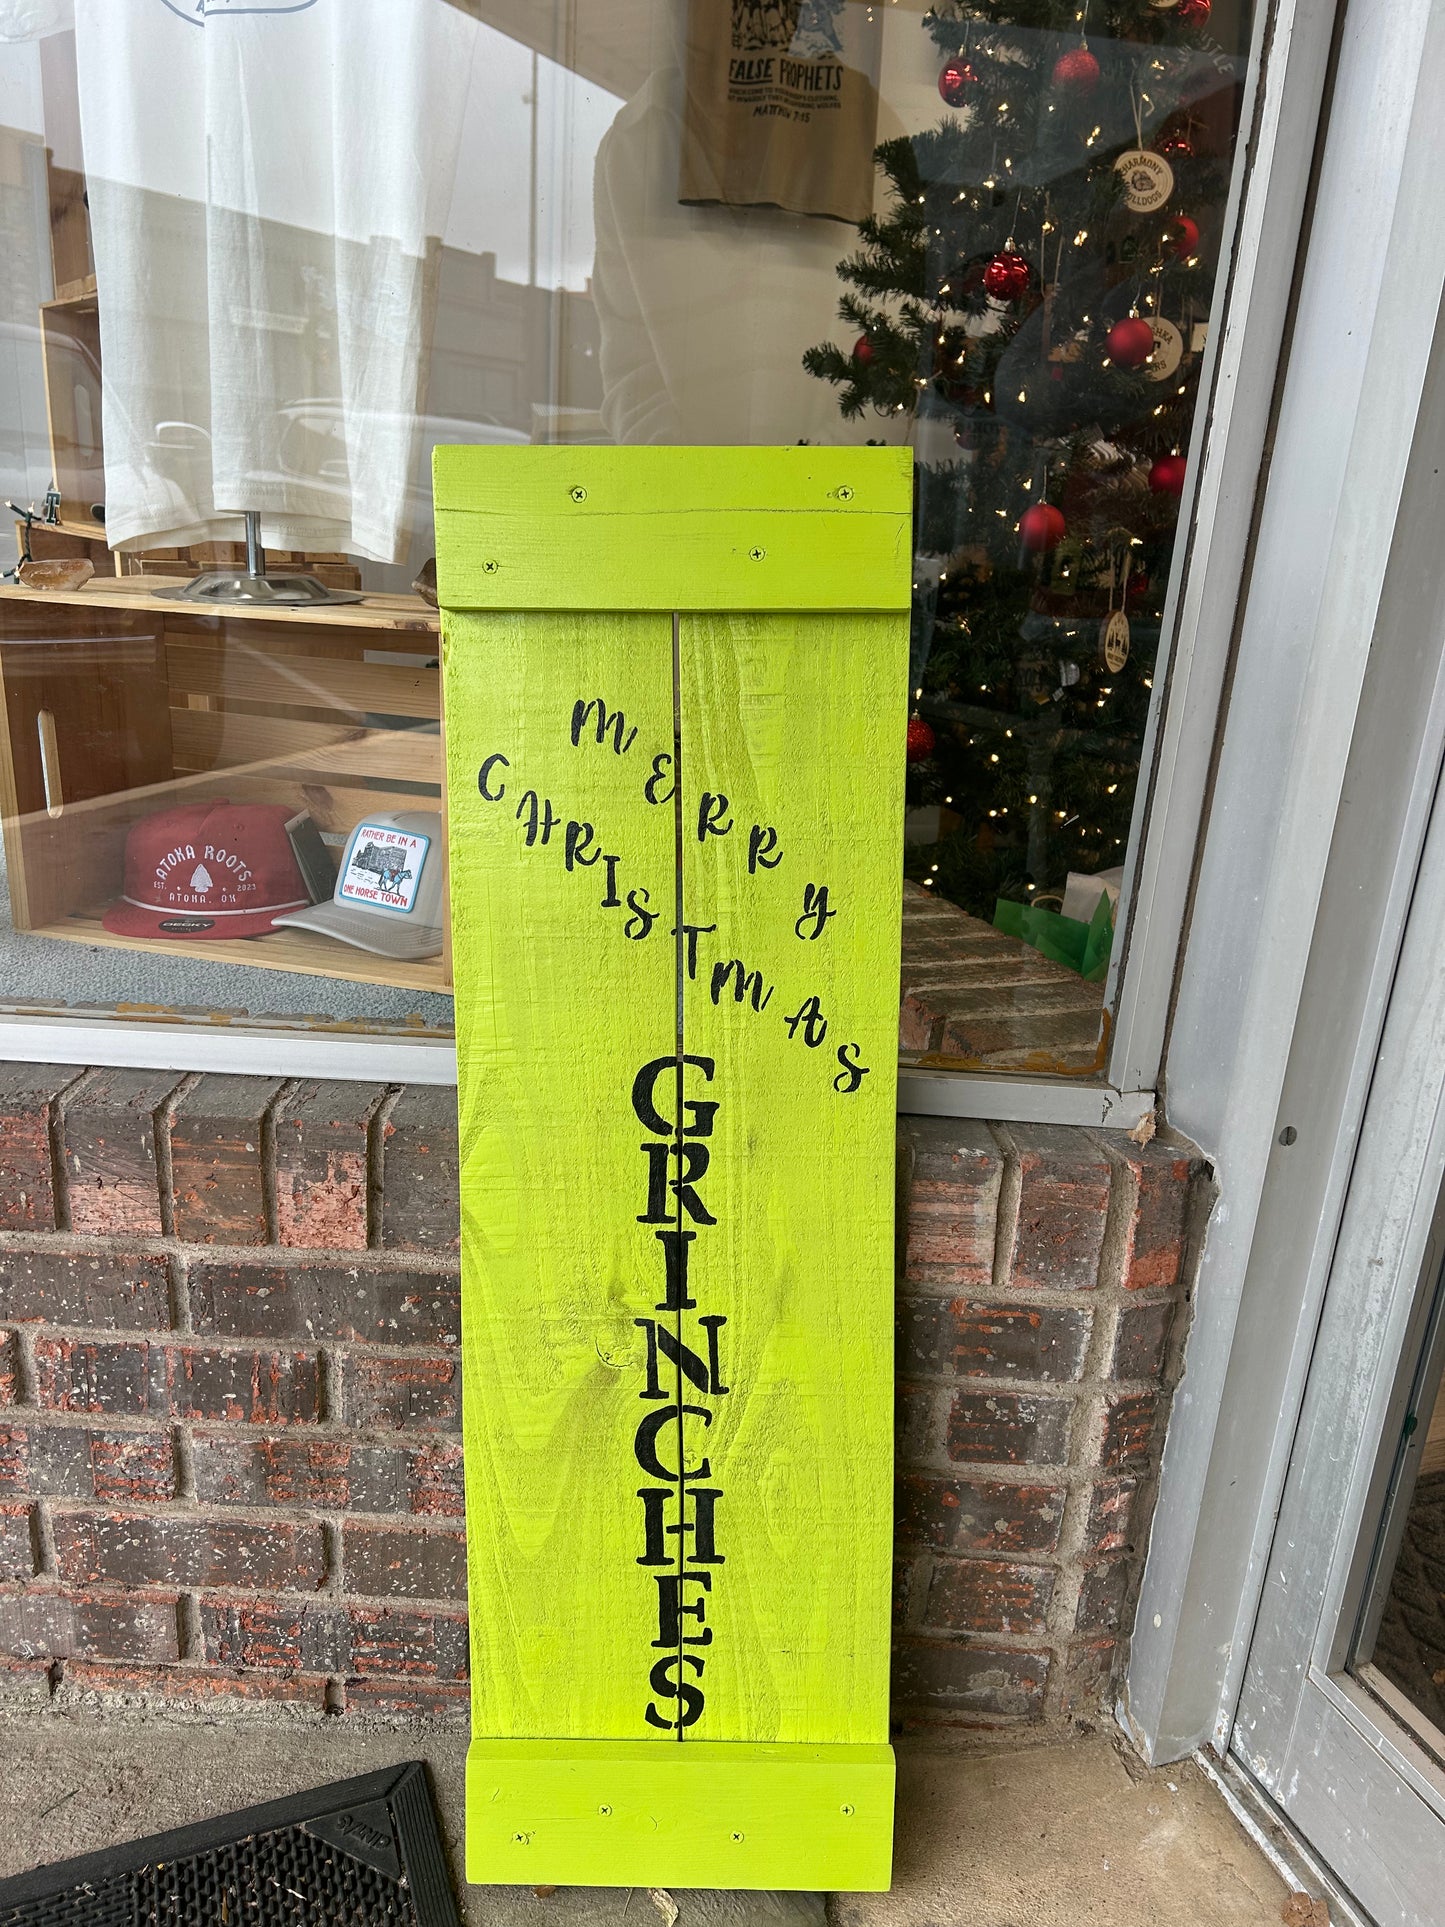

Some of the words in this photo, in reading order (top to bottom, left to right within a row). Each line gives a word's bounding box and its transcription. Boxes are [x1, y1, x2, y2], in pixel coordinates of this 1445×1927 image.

[728, 58, 775, 80] FALSE
[779, 58, 844, 91] PROPHETS
[1121, 155, 1163, 176] HARMONY
[1127, 190, 1163, 206] ULLDOGS
[361, 829, 385, 842] RATHER
[386, 834, 397, 844] BE
[398, 836, 408, 846] IN
[409, 839, 417, 848] A
[156, 845, 195, 880] ATOKA
[204, 845, 252, 881] ROOTS
[221, 894, 236, 903] OK
[237, 883, 257, 892] 2023
[343, 884, 355, 894] ONE
[355, 887, 379, 899] HORSE
[381, 892, 408, 907] TOWN
[478, 753, 869, 1092] CHRISTMAS
[632, 1054, 727, 1730] GRINCHES
